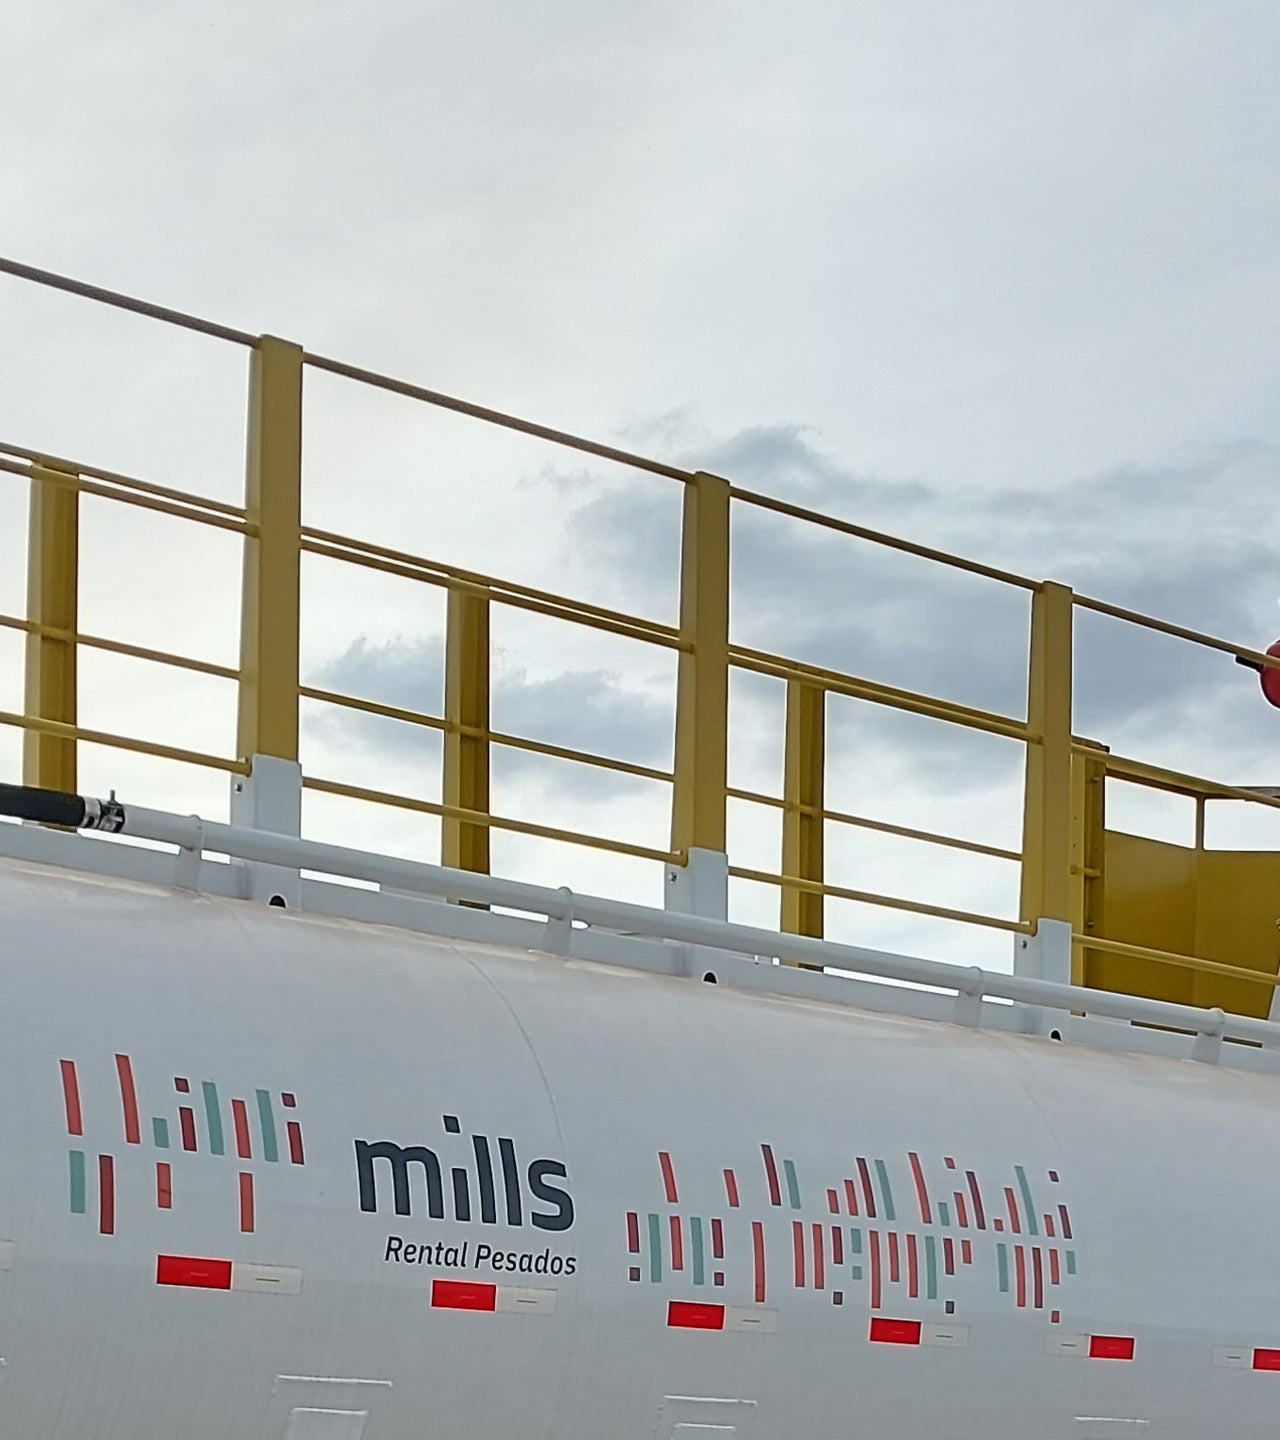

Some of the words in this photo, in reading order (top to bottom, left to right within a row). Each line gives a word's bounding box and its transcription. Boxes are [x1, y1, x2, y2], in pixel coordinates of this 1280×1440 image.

[354, 1114, 576, 1232] mills
[384, 1236, 468, 1268] Rental
[474, 1243, 577, 1276] Pesados
